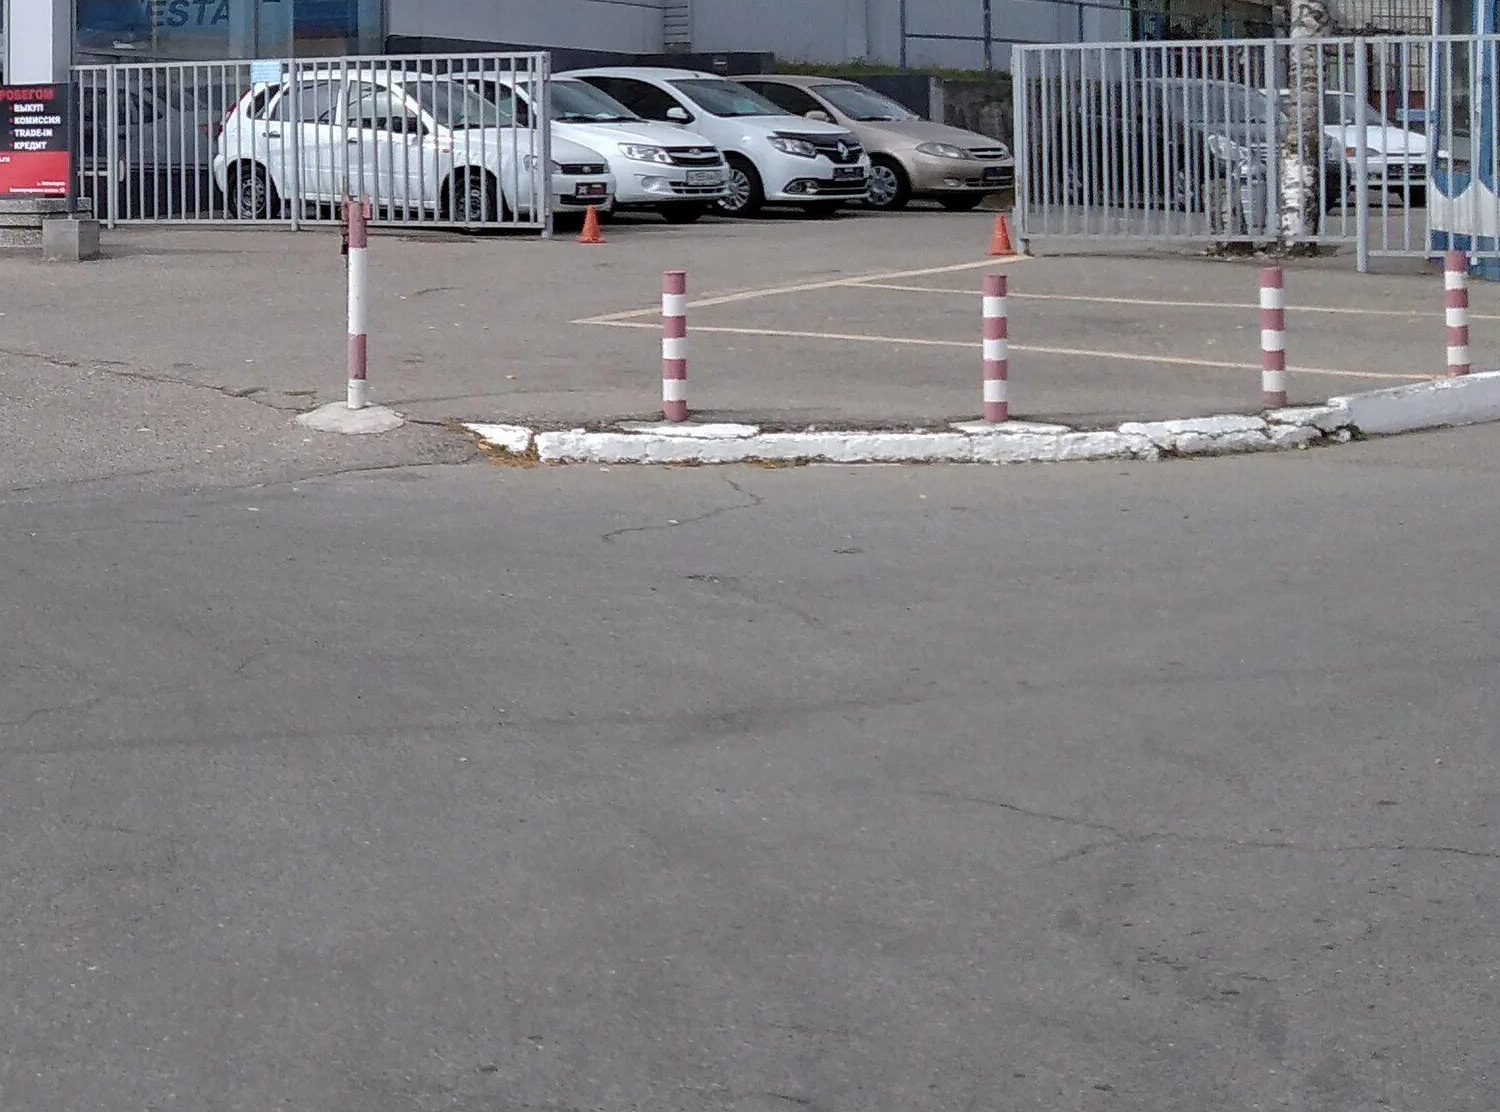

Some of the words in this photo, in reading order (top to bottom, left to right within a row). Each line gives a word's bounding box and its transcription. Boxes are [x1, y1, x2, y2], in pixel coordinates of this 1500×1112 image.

[13, 103, 44, 113] ВЫКУП
[13, 116, 61, 125] КОМИССИЯ
[14, 128, 53, 138] TRADE-IN
[13, 140, 48, 151] КРЕДИТ
